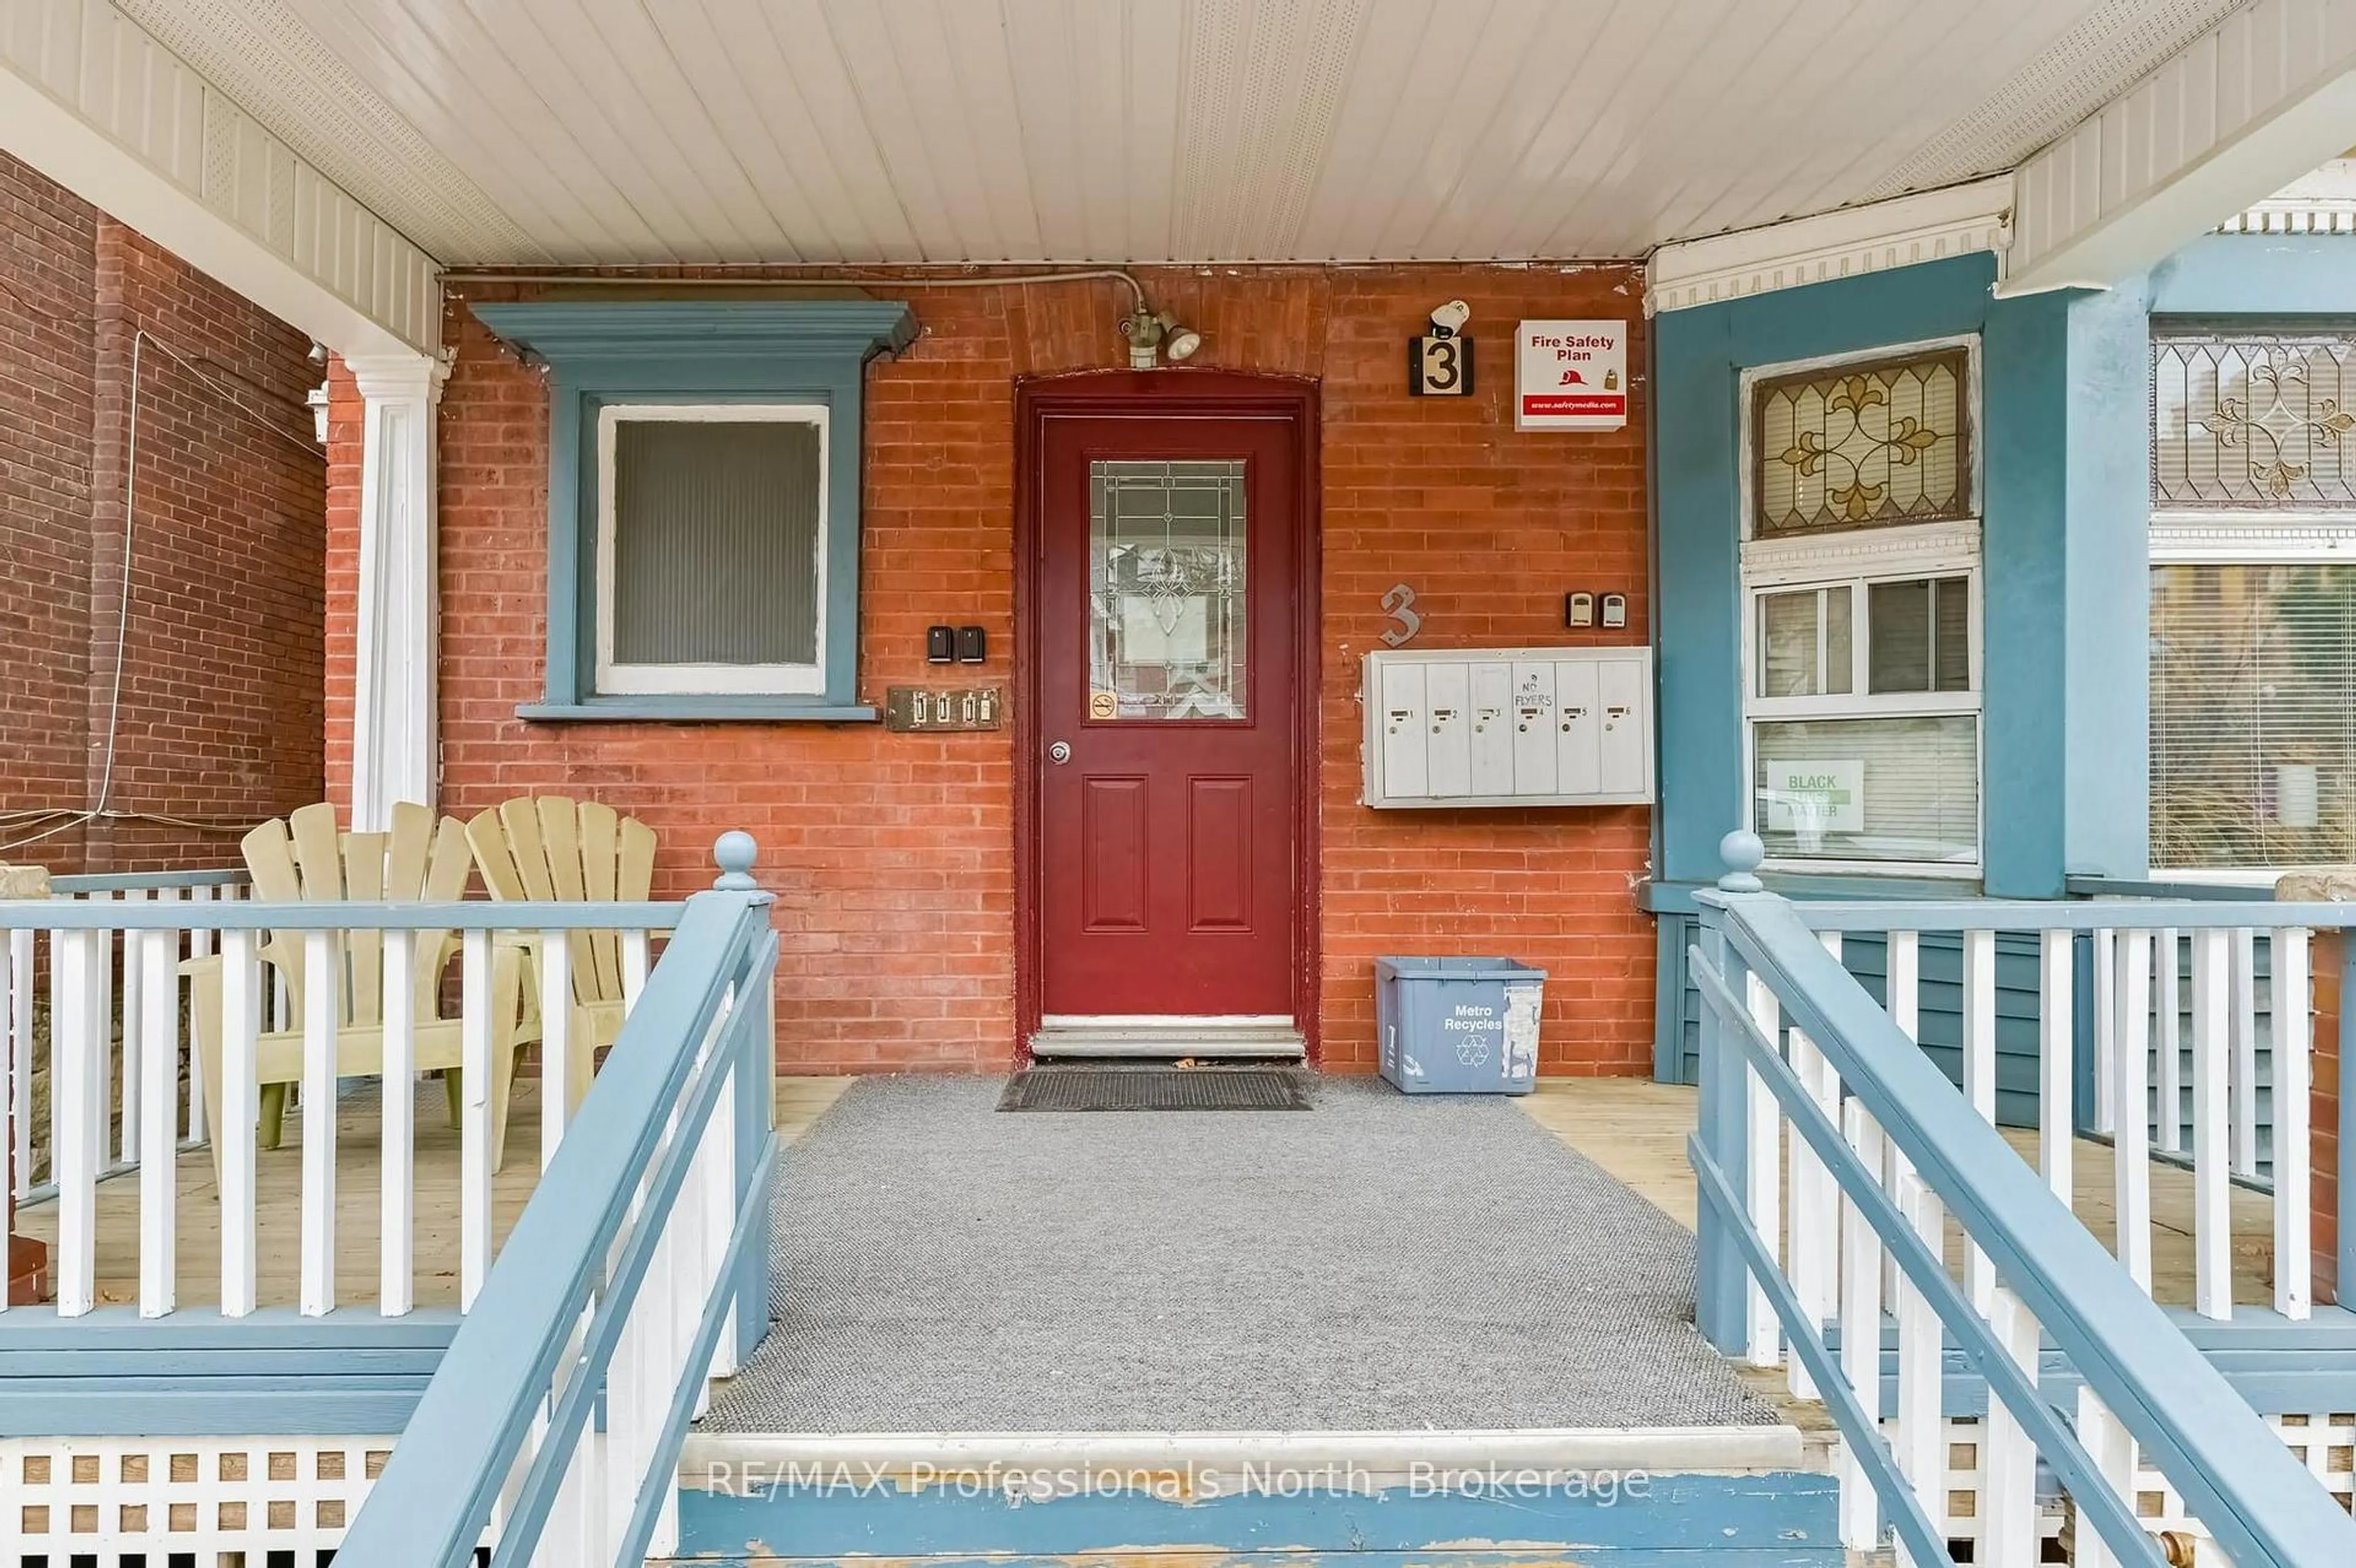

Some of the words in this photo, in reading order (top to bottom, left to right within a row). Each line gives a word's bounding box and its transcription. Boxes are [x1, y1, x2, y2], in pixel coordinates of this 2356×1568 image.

[1532, 337, 1560, 347] Fire
[1566, 336, 1614, 350] Safety
[1557, 350, 1591, 361] Plan
[1427, 342, 1458, 390] 3
[1379, 583, 1420, 648] 3
[1452, 709, 1458, 718] 2
[1582, 707, 1587, 716] 5
[1788, 775, 1836, 788] BLACK
[1455, 1005, 1492, 1017] Metro
[1444, 1018, 1503, 1032] Recycles
